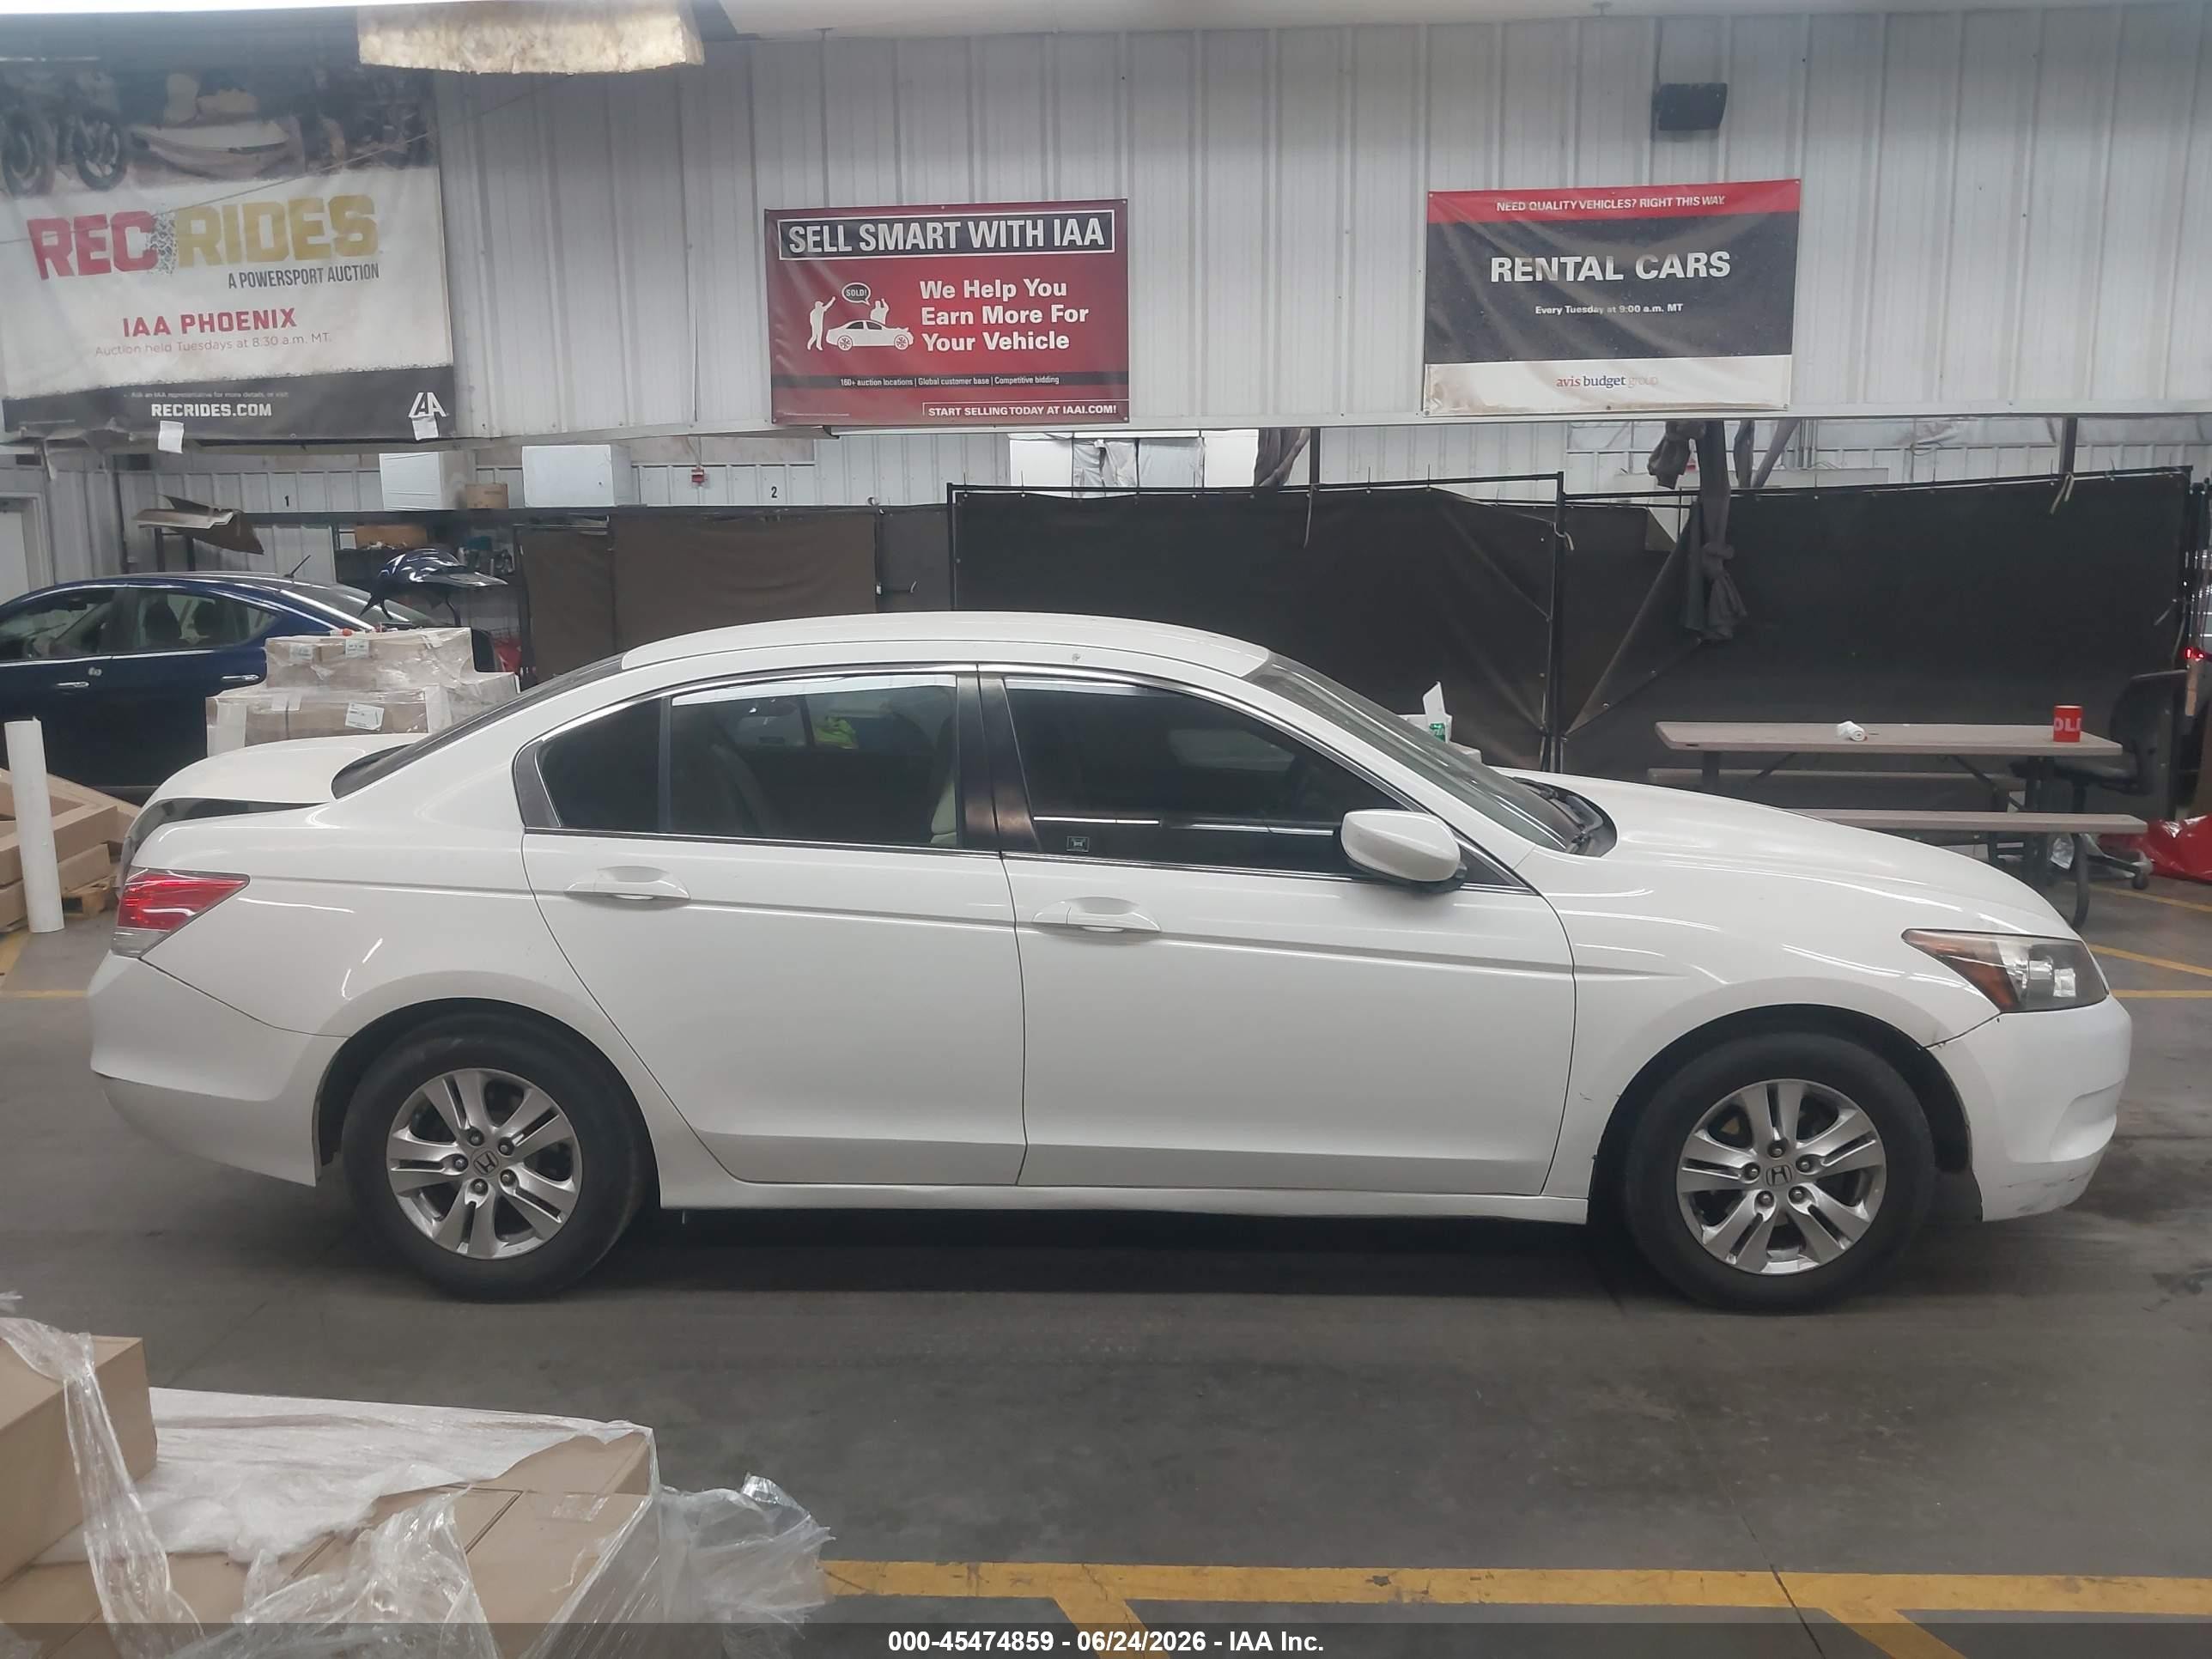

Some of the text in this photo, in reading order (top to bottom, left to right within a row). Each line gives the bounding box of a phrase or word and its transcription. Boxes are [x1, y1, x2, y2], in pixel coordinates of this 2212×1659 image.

[1497, 201, 1526, 211] NEED
[1528, 200, 1577, 211] QUALITY
[1578, 198, 1638, 210] VEHICLES?
[1639, 198, 1673, 207] RIGHT
[1675, 197, 1700, 206] THIS
[26, 194, 379, 281] REC RIDES
[789, 218, 1105, 253] SELL SMART WITH IAA
[1491, 251, 1731, 283] RENTAL CARS
[228, 263, 380, 289] A POWERSPORT AUCTION
[846, 289, 867, 297] SOLD!
[920, 278, 1067, 301] We Help You
[921, 304, 1089, 325] Earn More For
[1535, 306, 1562, 315] Every
[1565, 305, 1604, 314] Tuesday
[1667, 303, 1684, 312] MT
[123, 307, 297, 337] IAA PHOENIX
[95, 345, 142, 356] Auction
[145, 343, 172, 352] held
[177, 339, 233, 352] Tuesdays
[236, 339, 248, 348] at
[921, 331, 1070, 352] Your Vehicle
[918, 377, 939, 386] Global
[994, 376, 1034, 386] Competitive
[1035, 376, 1060, 385] bidding
[1556, 376, 1581, 386] avis
[1583, 376, 1626, 388] budget
[150, 404, 272, 417] RECRIDES.COM
[928, 404, 1117, 416] START SELLING TODAY AT IAAI.COM!
[770, 486, 778, 499] 2
[284, 495, 289, 507] 1
